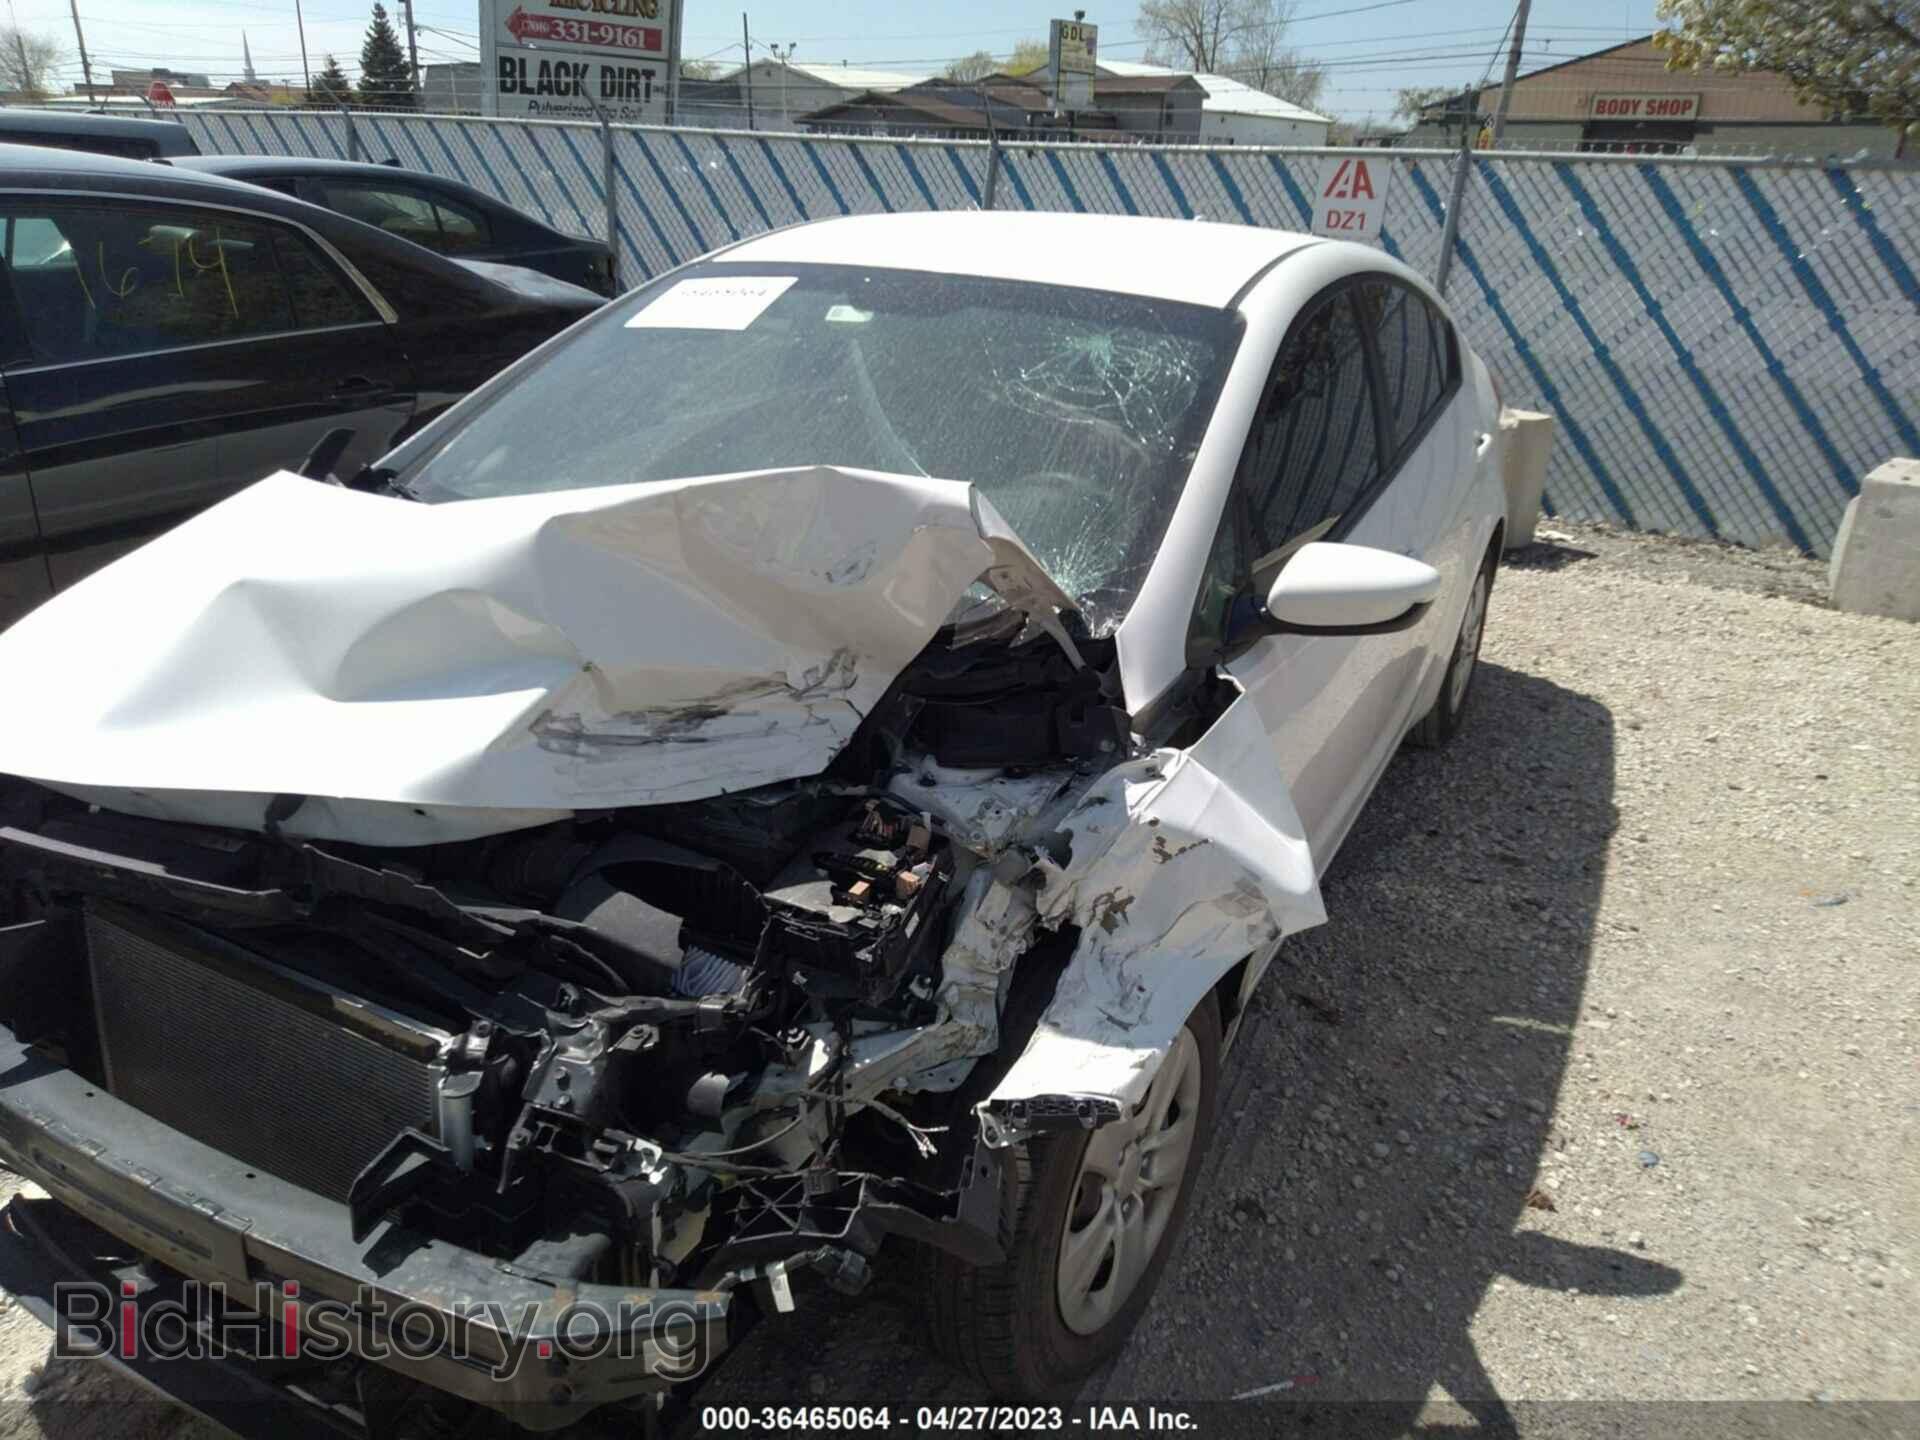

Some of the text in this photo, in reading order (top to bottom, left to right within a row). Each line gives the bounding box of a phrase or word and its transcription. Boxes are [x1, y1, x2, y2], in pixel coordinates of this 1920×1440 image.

[551, 20, 646, 48] 331-9161
[499, 55, 656, 103] BLACK DIRT
[1594, 98, 1694, 116] BODY SHOP
[1326, 209, 1366, 231] DZ1
